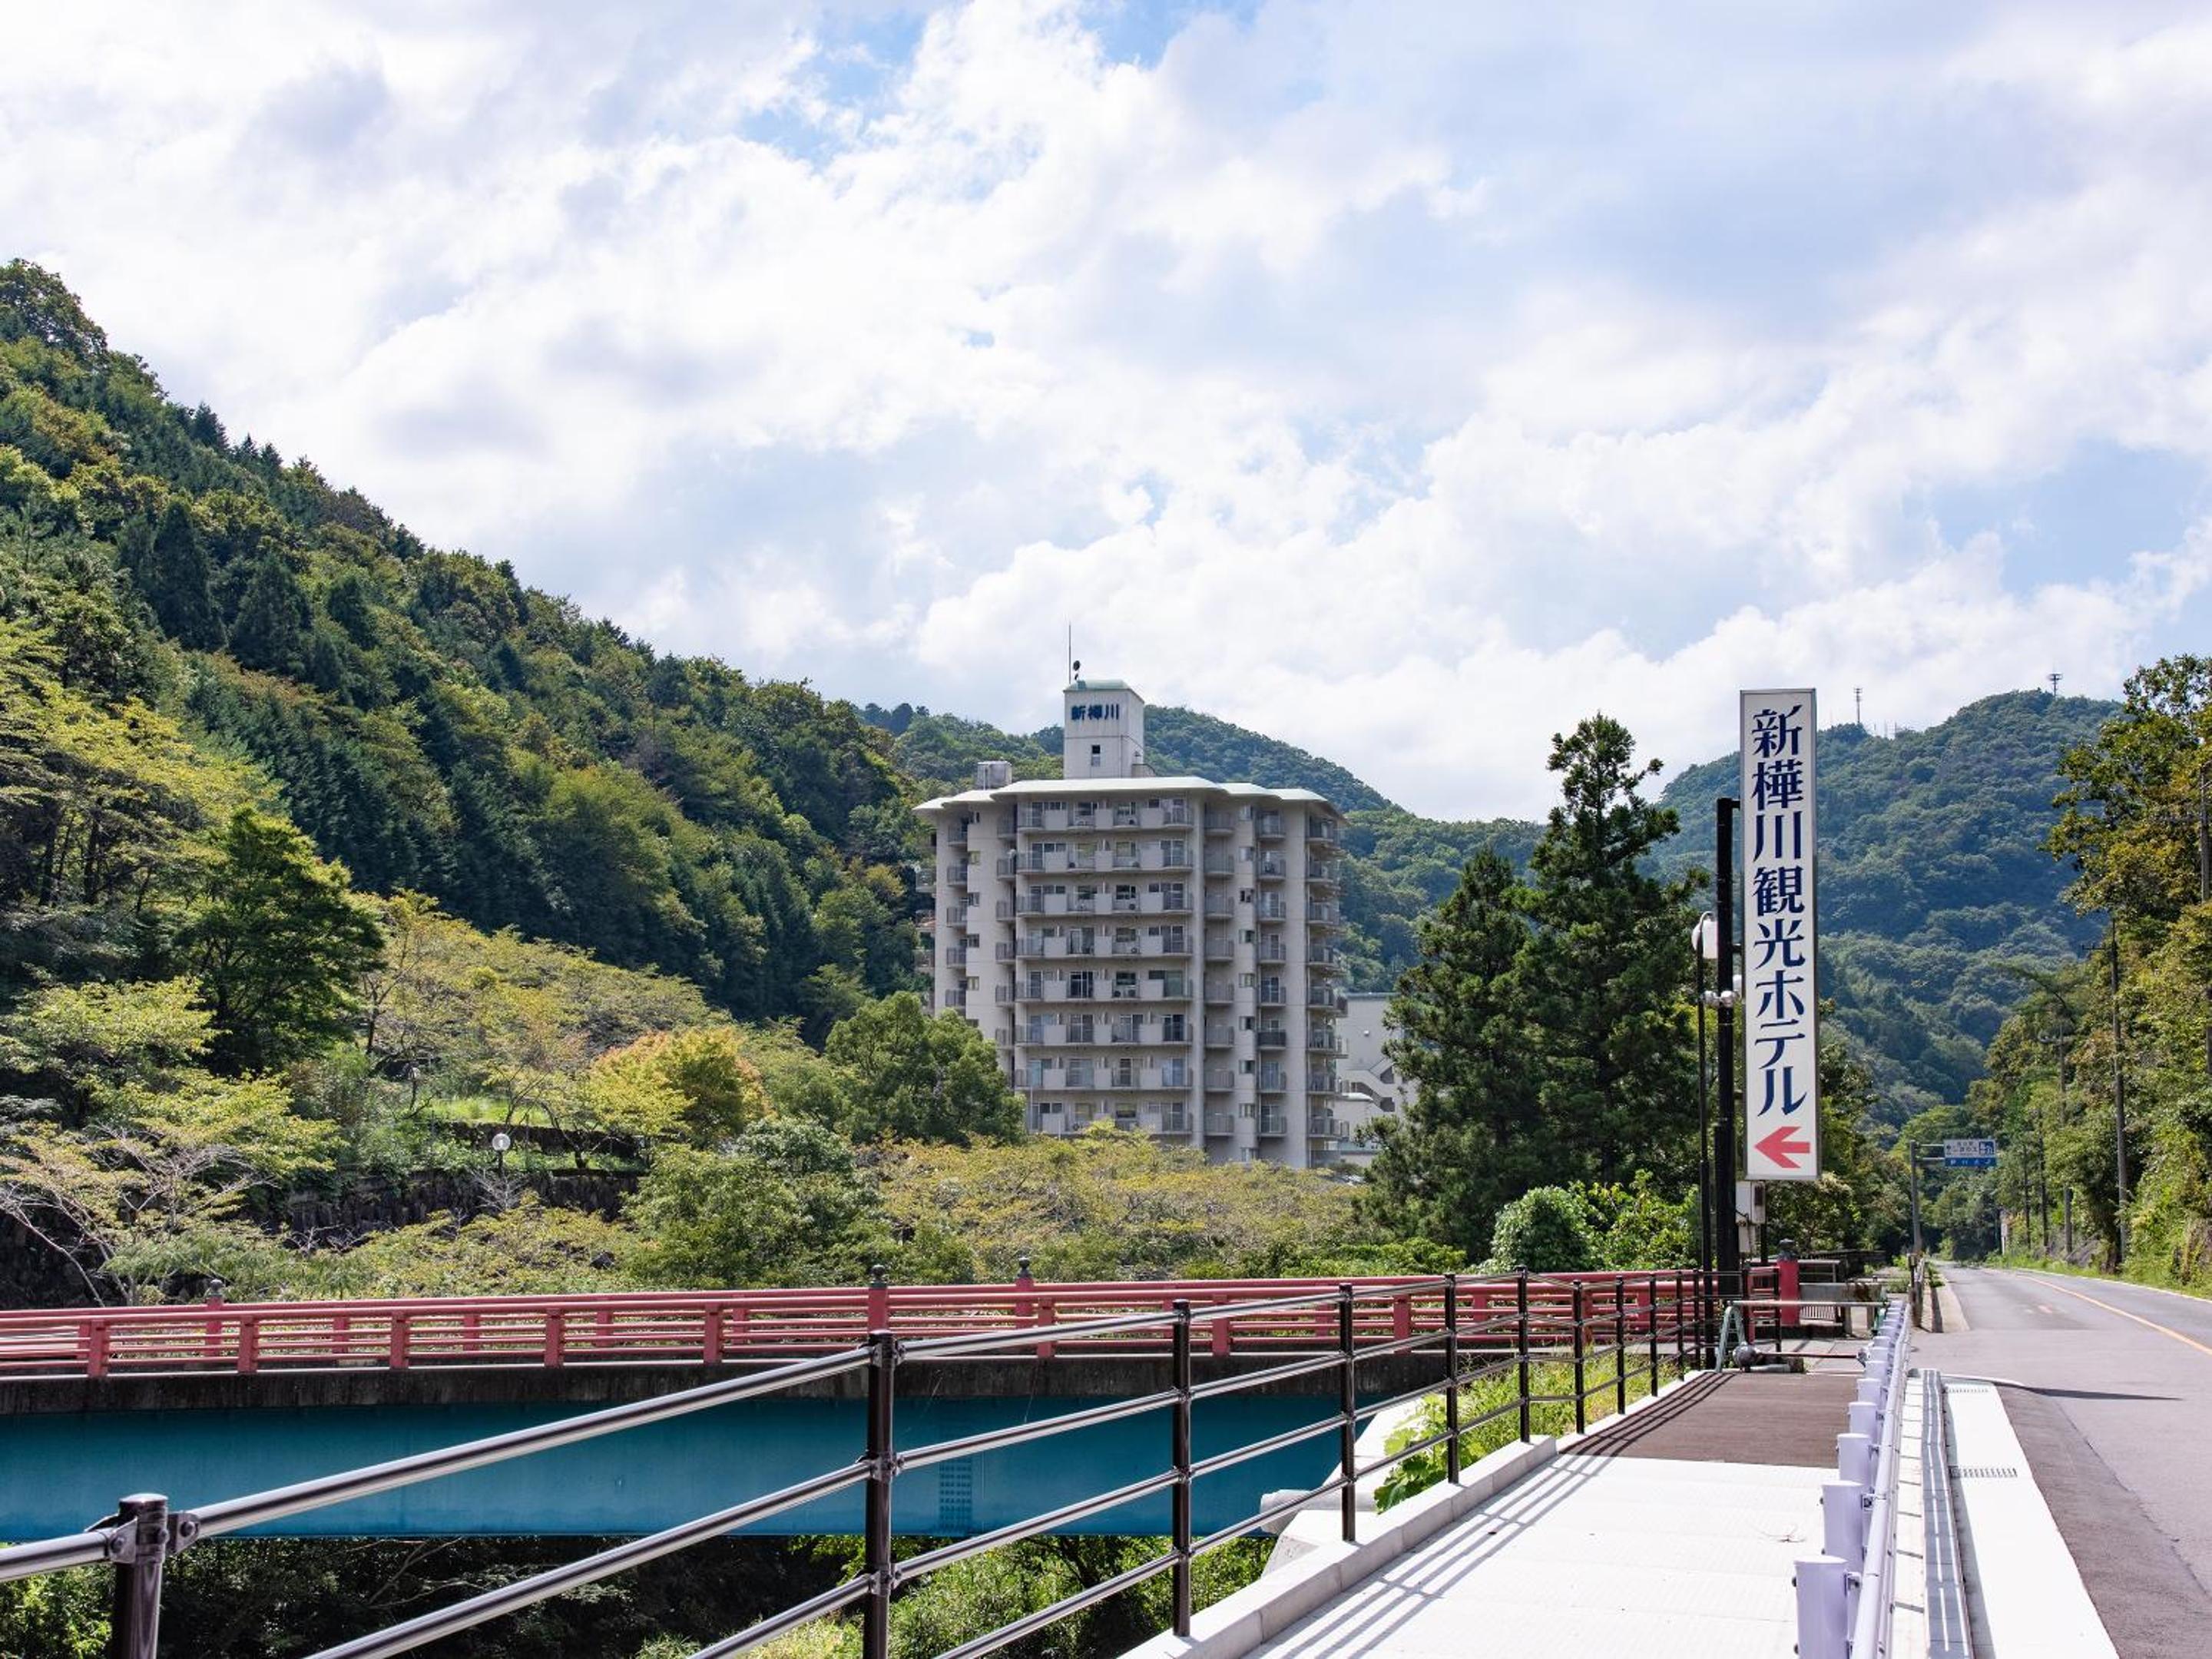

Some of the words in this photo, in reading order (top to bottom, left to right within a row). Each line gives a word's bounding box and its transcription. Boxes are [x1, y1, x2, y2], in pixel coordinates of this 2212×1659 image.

[1751, 704, 1807, 1117] 新樺川観光ホテル
